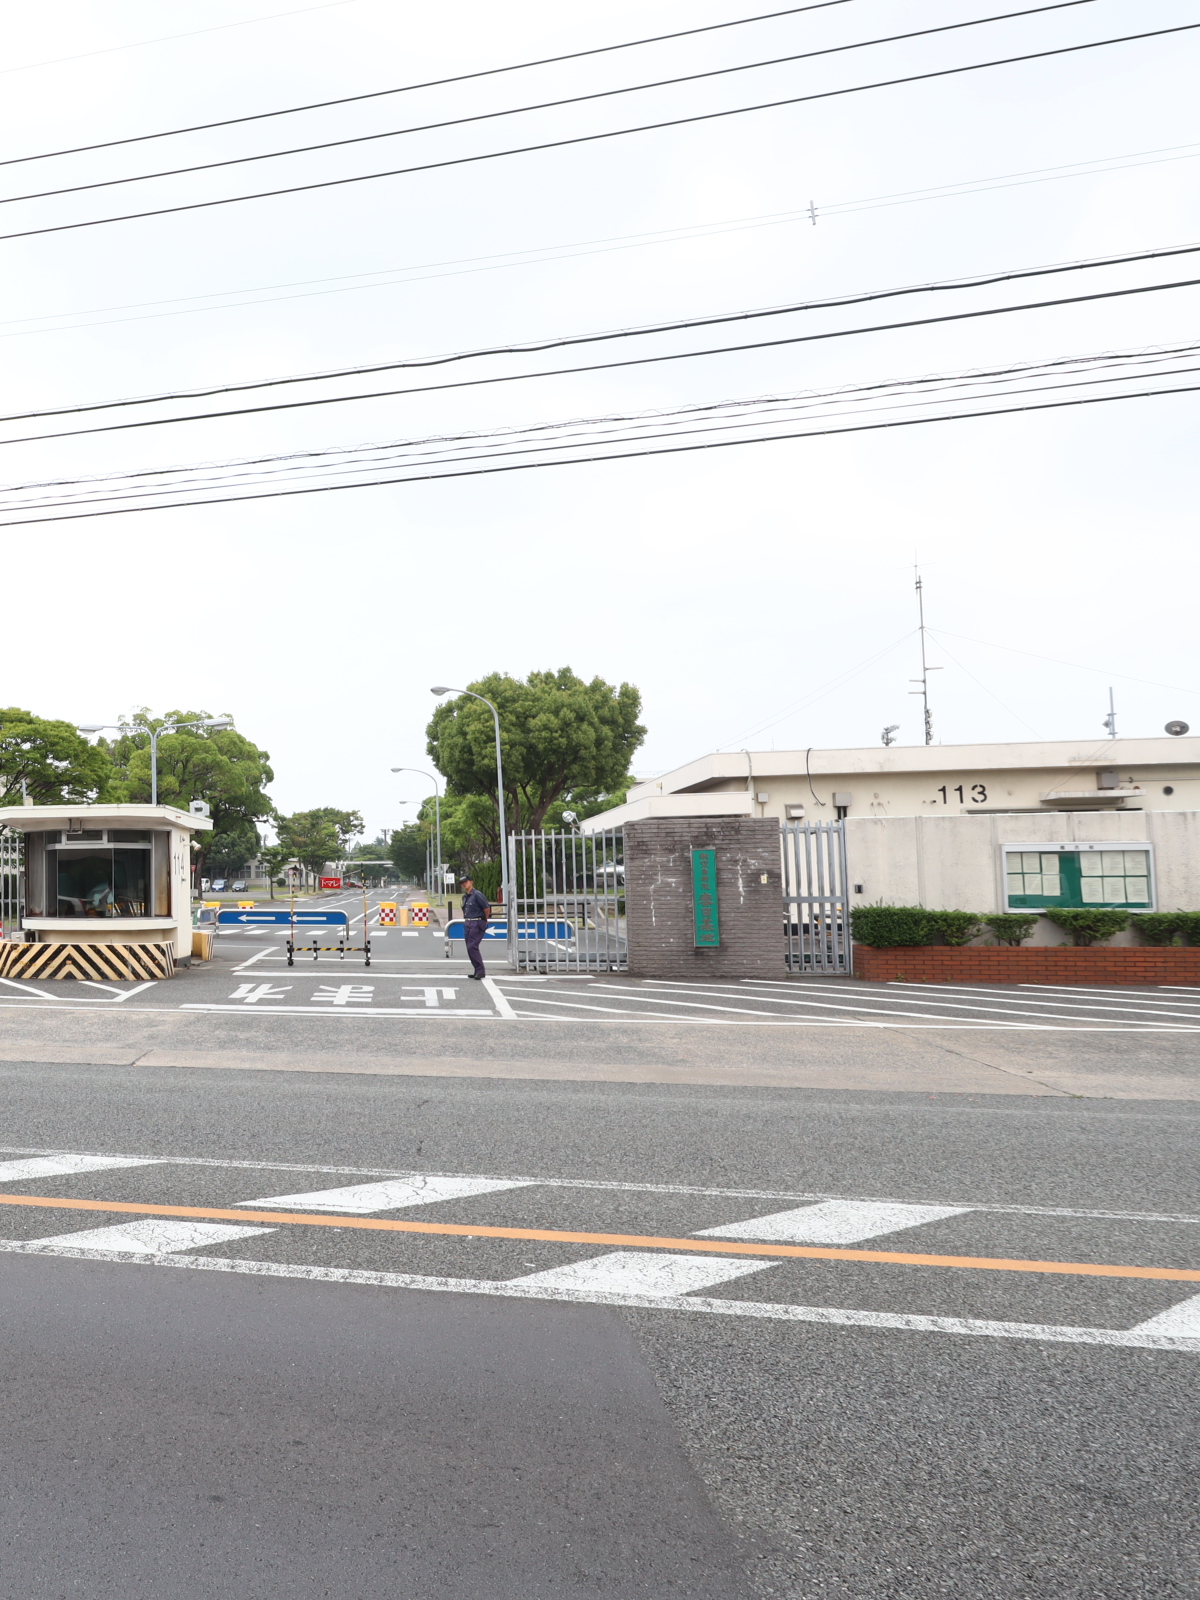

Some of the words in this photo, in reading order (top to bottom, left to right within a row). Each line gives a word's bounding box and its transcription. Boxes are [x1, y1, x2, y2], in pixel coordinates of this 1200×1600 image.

[937, 784, 988, 804] 113
[321, 879, 340, 888] トマレ
